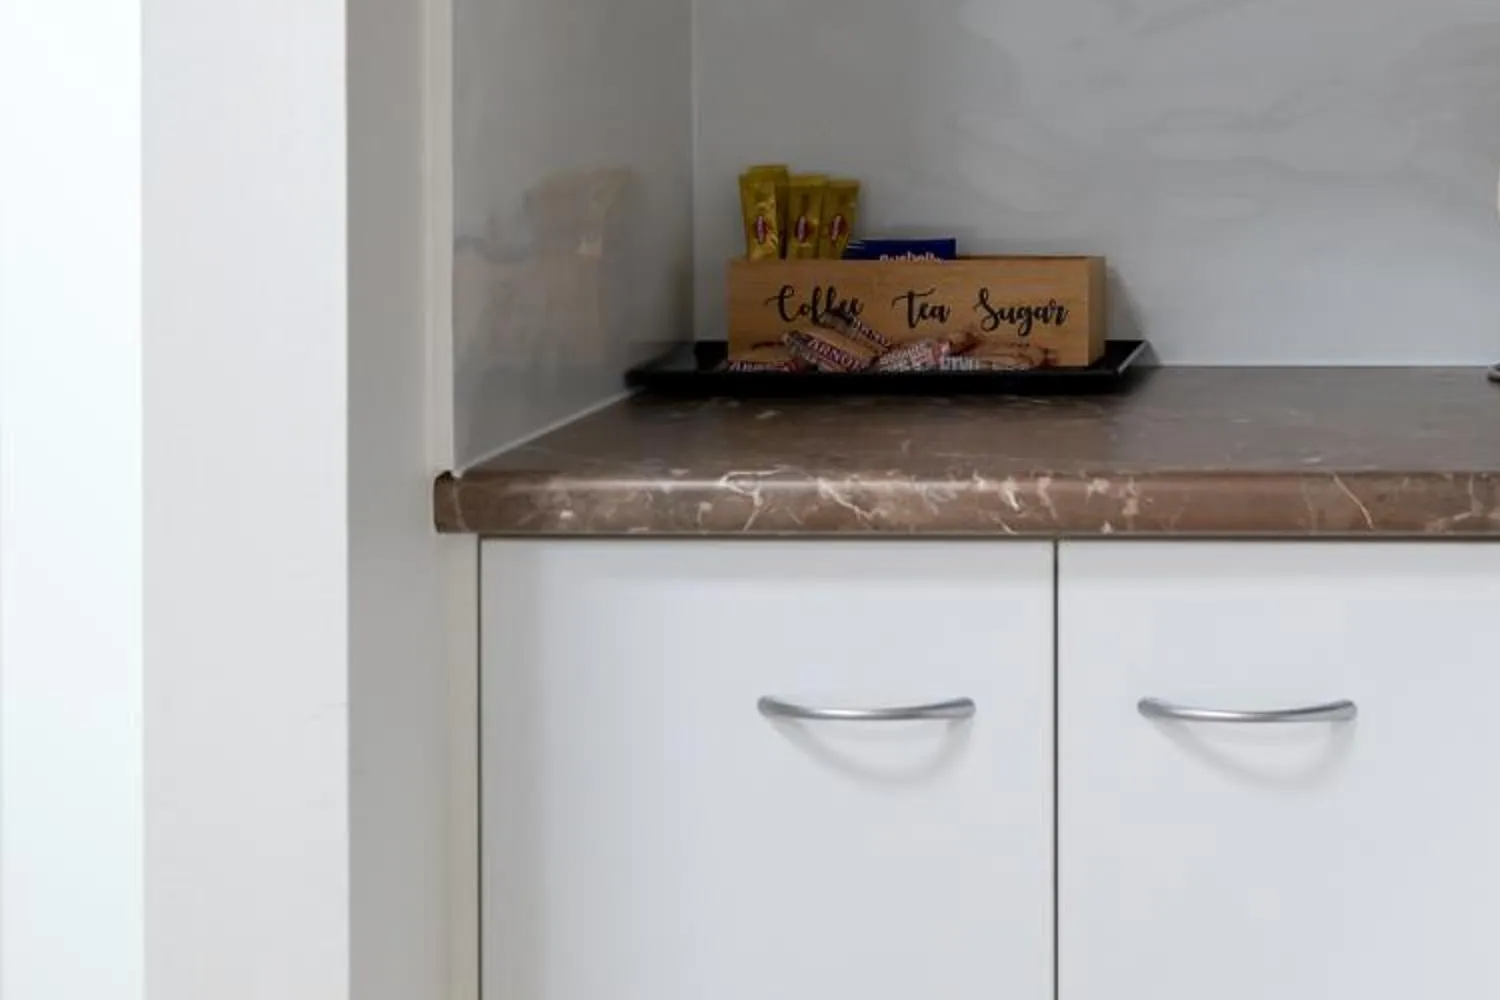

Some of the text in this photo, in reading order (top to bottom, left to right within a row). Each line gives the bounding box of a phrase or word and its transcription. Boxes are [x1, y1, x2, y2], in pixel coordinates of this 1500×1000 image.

[764, 284, 1070, 336] Coffee Tea Sugar
